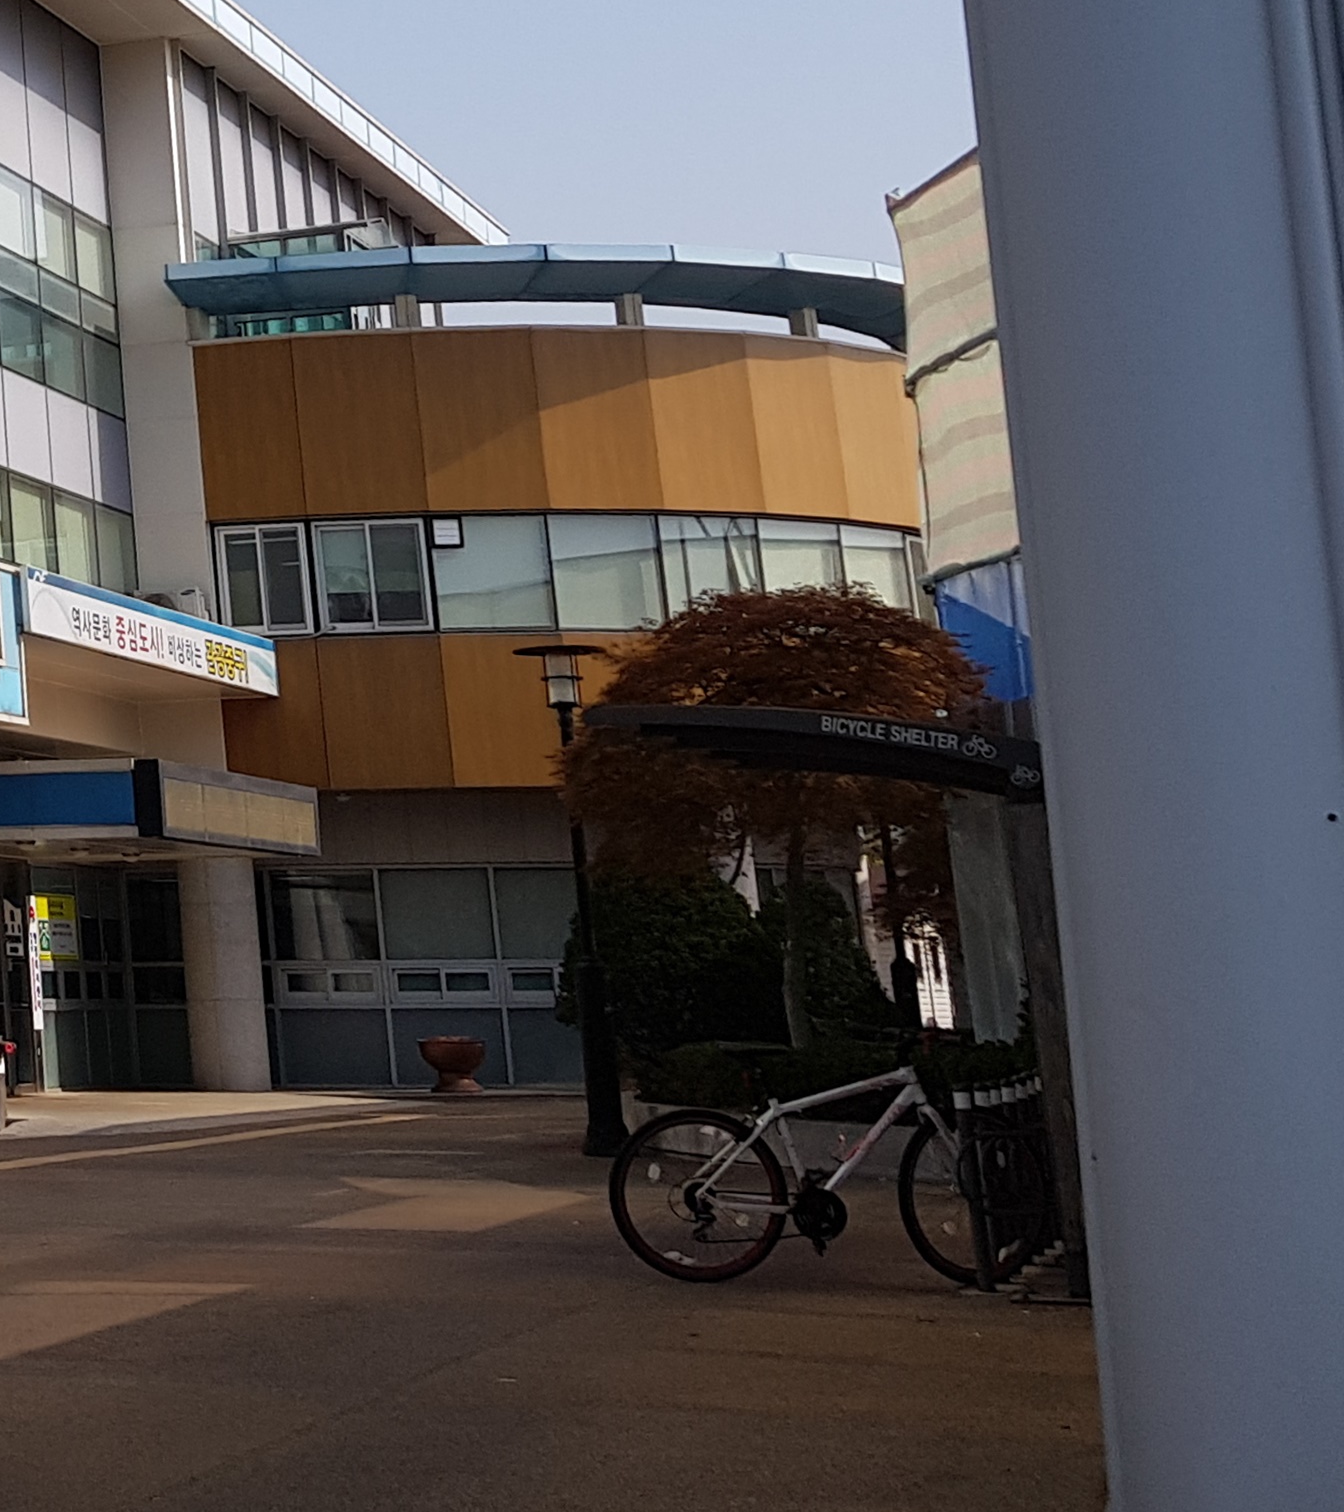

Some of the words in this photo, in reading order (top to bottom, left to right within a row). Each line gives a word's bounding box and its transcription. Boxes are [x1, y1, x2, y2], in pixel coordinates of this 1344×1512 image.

[71, 607, 112, 645] 역사문화
[115, 615, 164, 660] 중심도시!
[821, 715, 887, 741] BICYCLE
[889, 725, 959, 751] SHELTER
